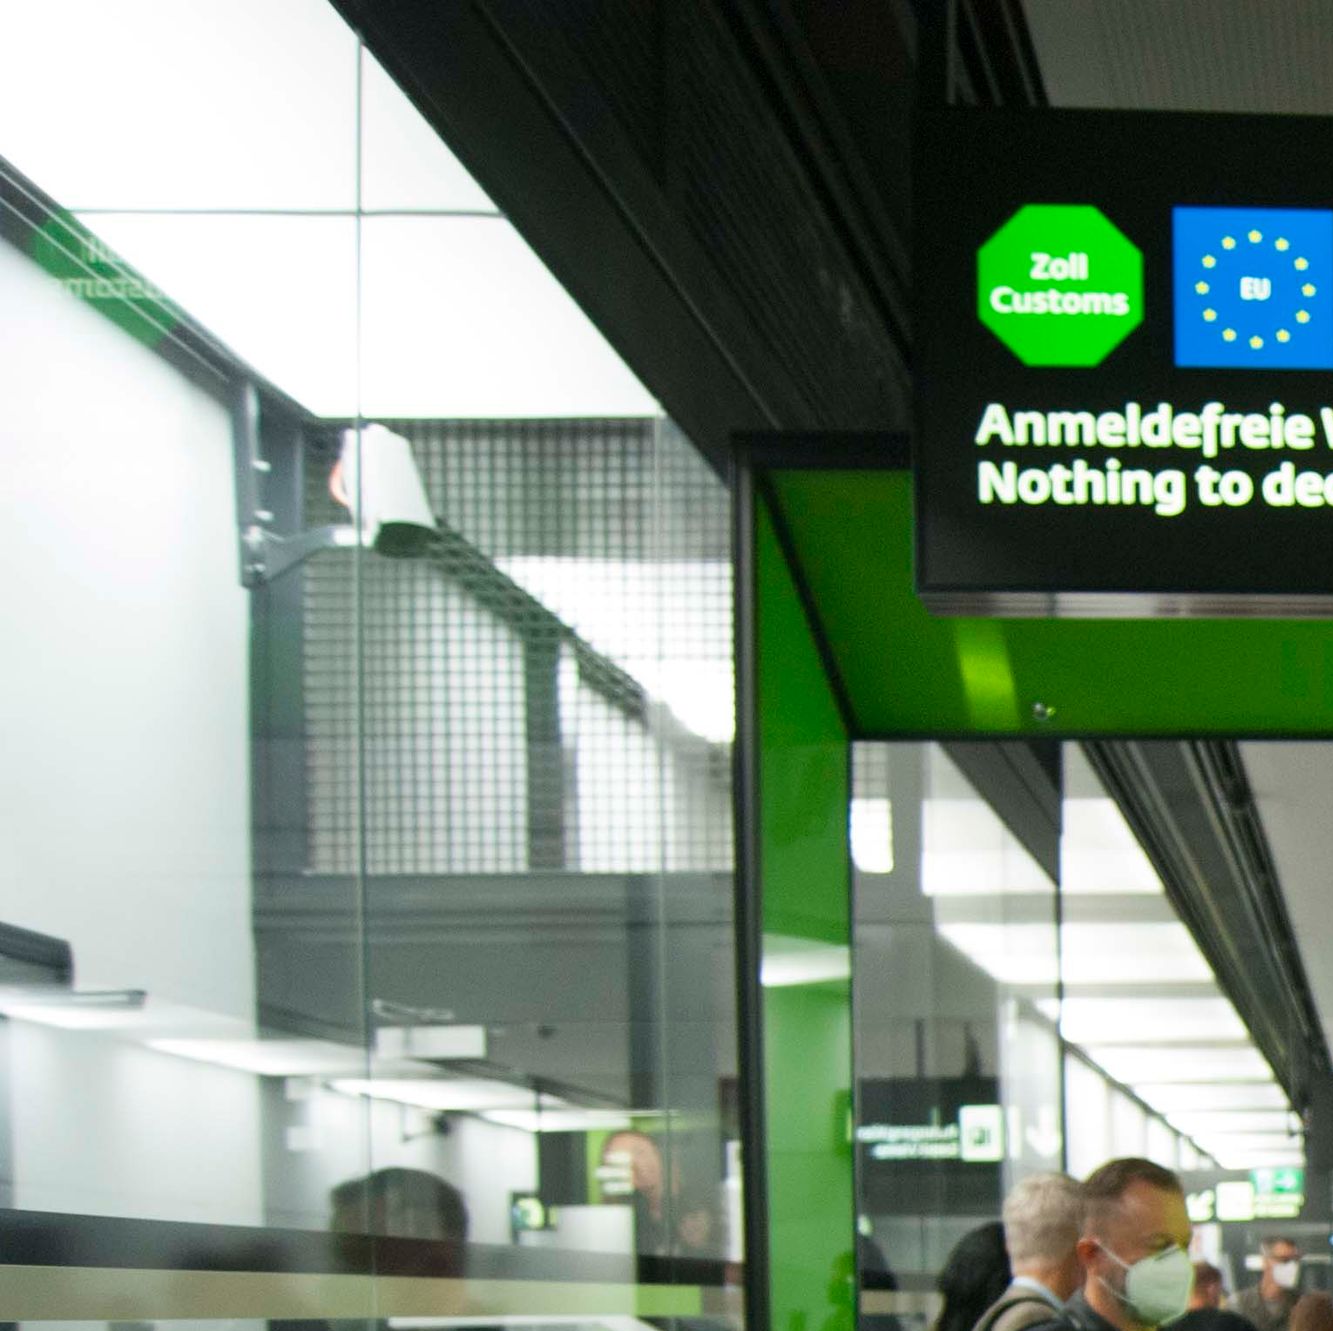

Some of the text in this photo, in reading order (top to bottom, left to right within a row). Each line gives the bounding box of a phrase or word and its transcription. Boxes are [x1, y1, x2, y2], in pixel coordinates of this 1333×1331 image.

[1029, 252, 1089, 281] Zoll
[990, 286, 1130, 316] Customs
[1239, 277, 1271, 301] EU
[975, 401, 1315, 458] Anmeldefreie
[977, 457, 1187, 517] Nothing
[1194, 464, 1254, 507] to
